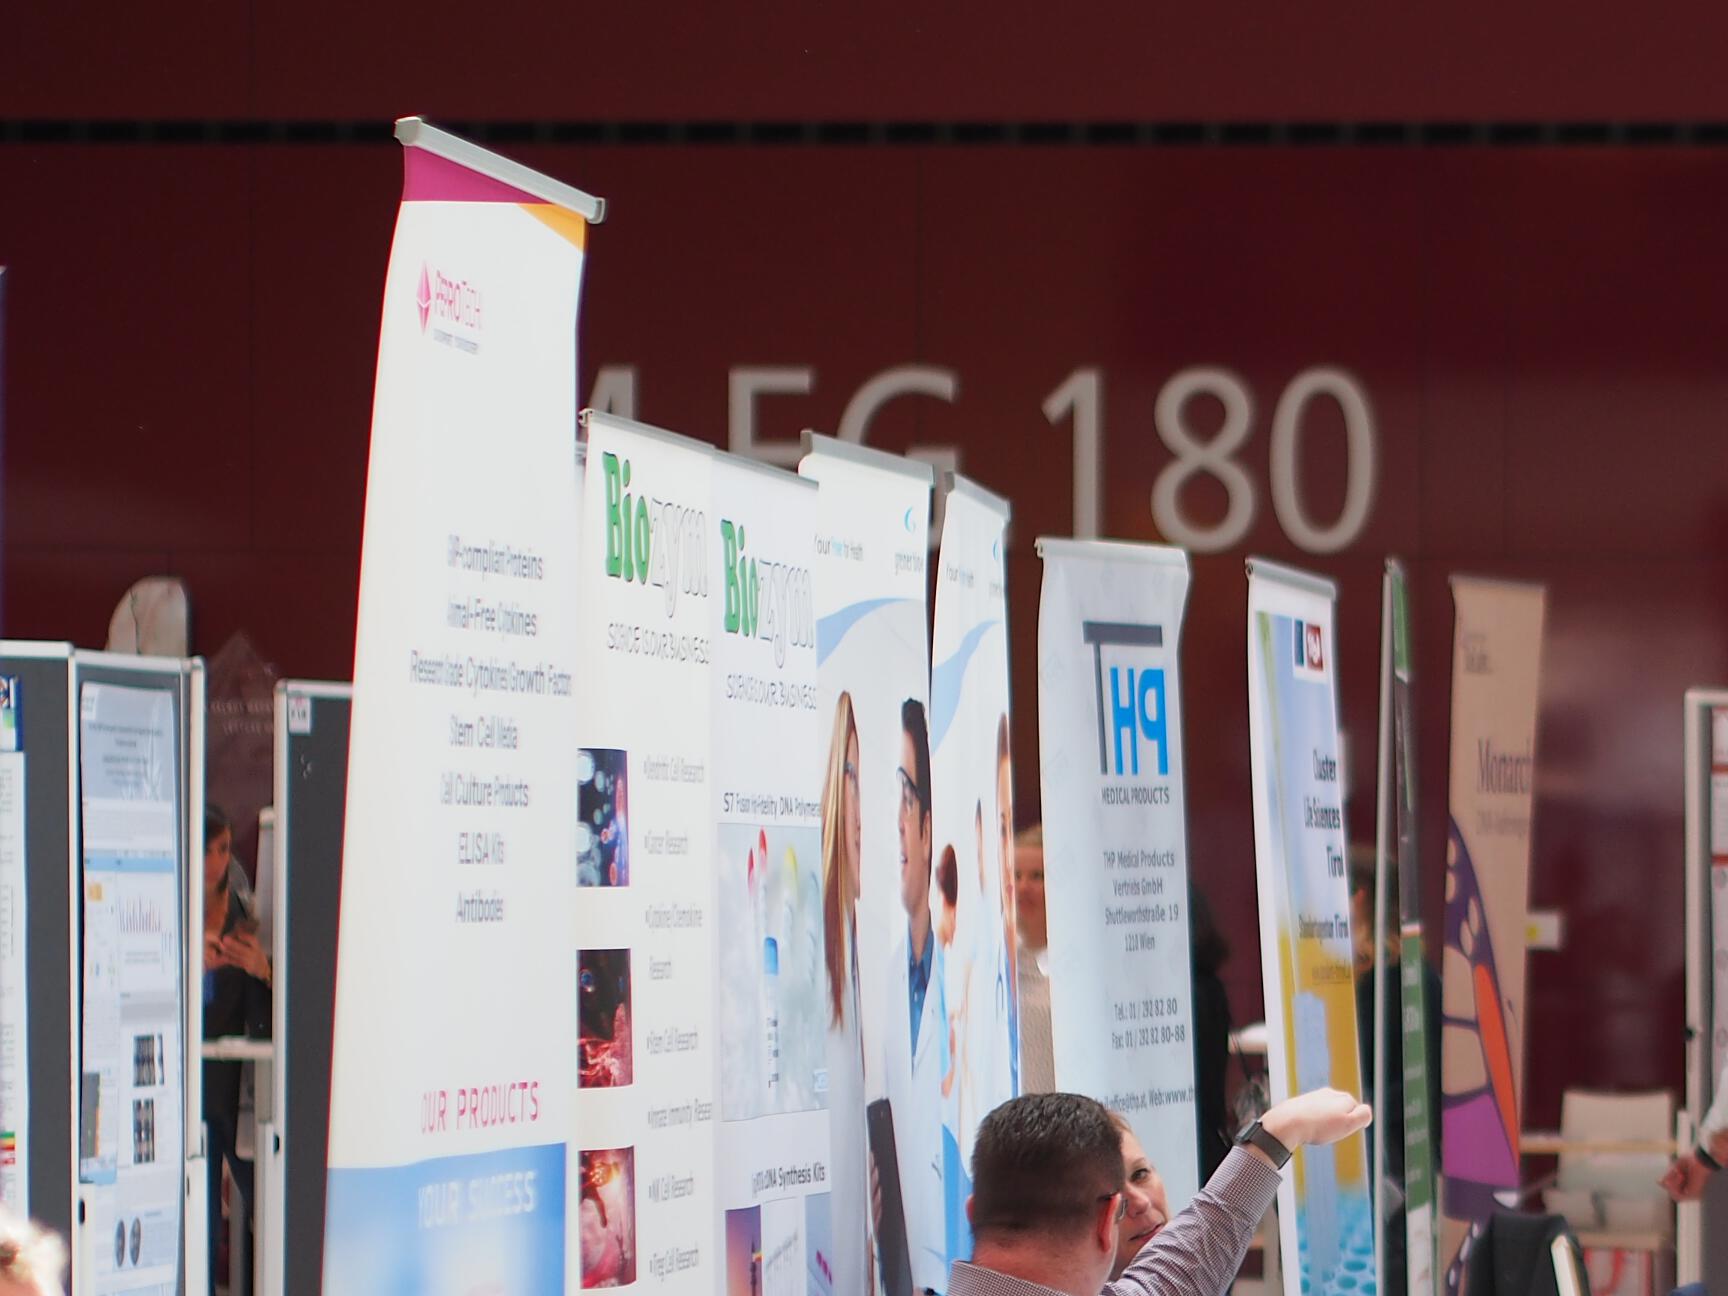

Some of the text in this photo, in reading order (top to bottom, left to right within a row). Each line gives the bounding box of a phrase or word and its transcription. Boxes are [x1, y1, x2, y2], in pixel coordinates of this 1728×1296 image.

[1040, 366, 1378, 556] 180
[1168, 903, 1179, 922] 19
[1166, 997, 1178, 1016] 80
[1161, 1023, 1186, 1044] 80-88
[456, 1080, 539, 1131] PRODUCTS
